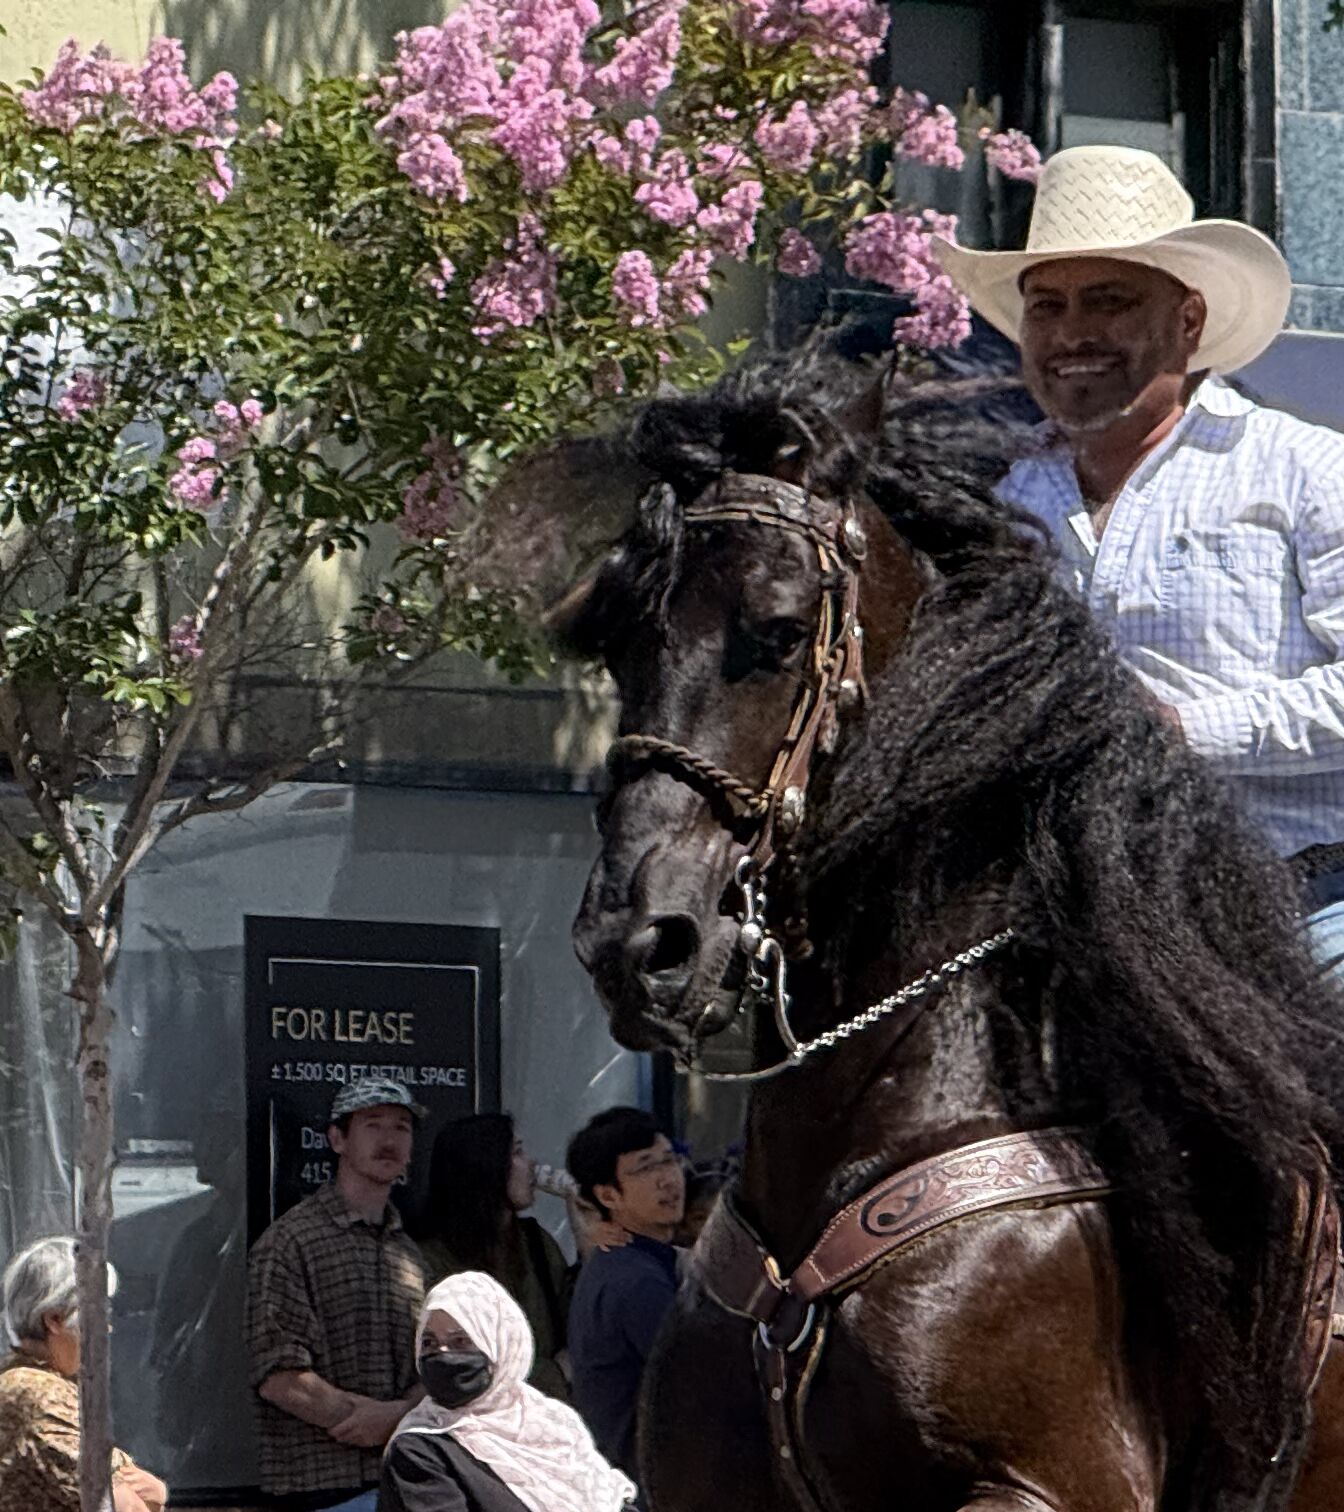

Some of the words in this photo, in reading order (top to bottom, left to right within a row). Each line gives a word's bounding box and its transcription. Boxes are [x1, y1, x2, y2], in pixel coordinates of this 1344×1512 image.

[271, 1007, 328, 1042] FOR
[334, 1009, 415, 1045] LEASE
[284, 1062, 323, 1082] 1,500
[325, 1063, 346, 1084] SQ
[420, 1067, 467, 1087] SPACE
